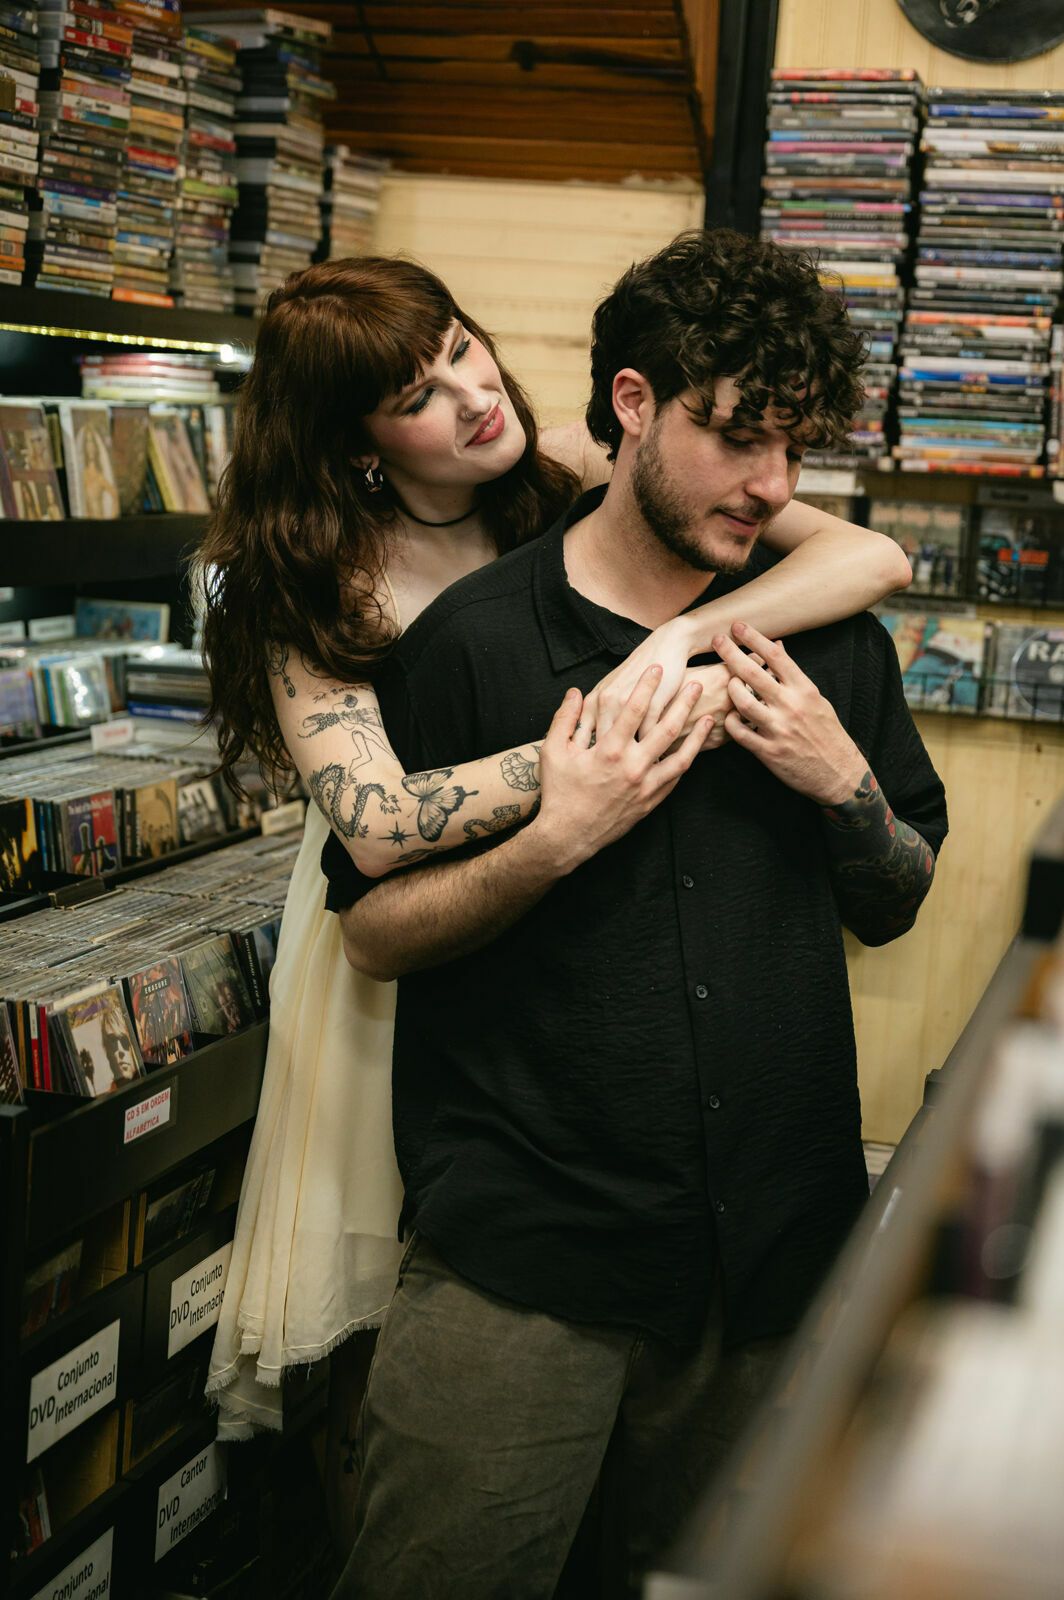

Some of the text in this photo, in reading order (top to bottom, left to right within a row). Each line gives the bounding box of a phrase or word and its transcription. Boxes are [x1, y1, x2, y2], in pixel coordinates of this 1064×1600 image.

[144, 979, 168, 995] ERASURE
[150, 1090, 170, 1109] ORDEM
[190, 1264, 223, 1297] Conjunto
[170, 1289, 225, 1330] DVD Internacio
[57, 1351, 100, 1392] Conjunto
[29, 1364, 116, 1431] DVD Internacional
[180, 1455, 208, 1488] Cantor
[158, 1495, 180, 1529] DVD
[170, 1489, 221, 1543] Internacion
